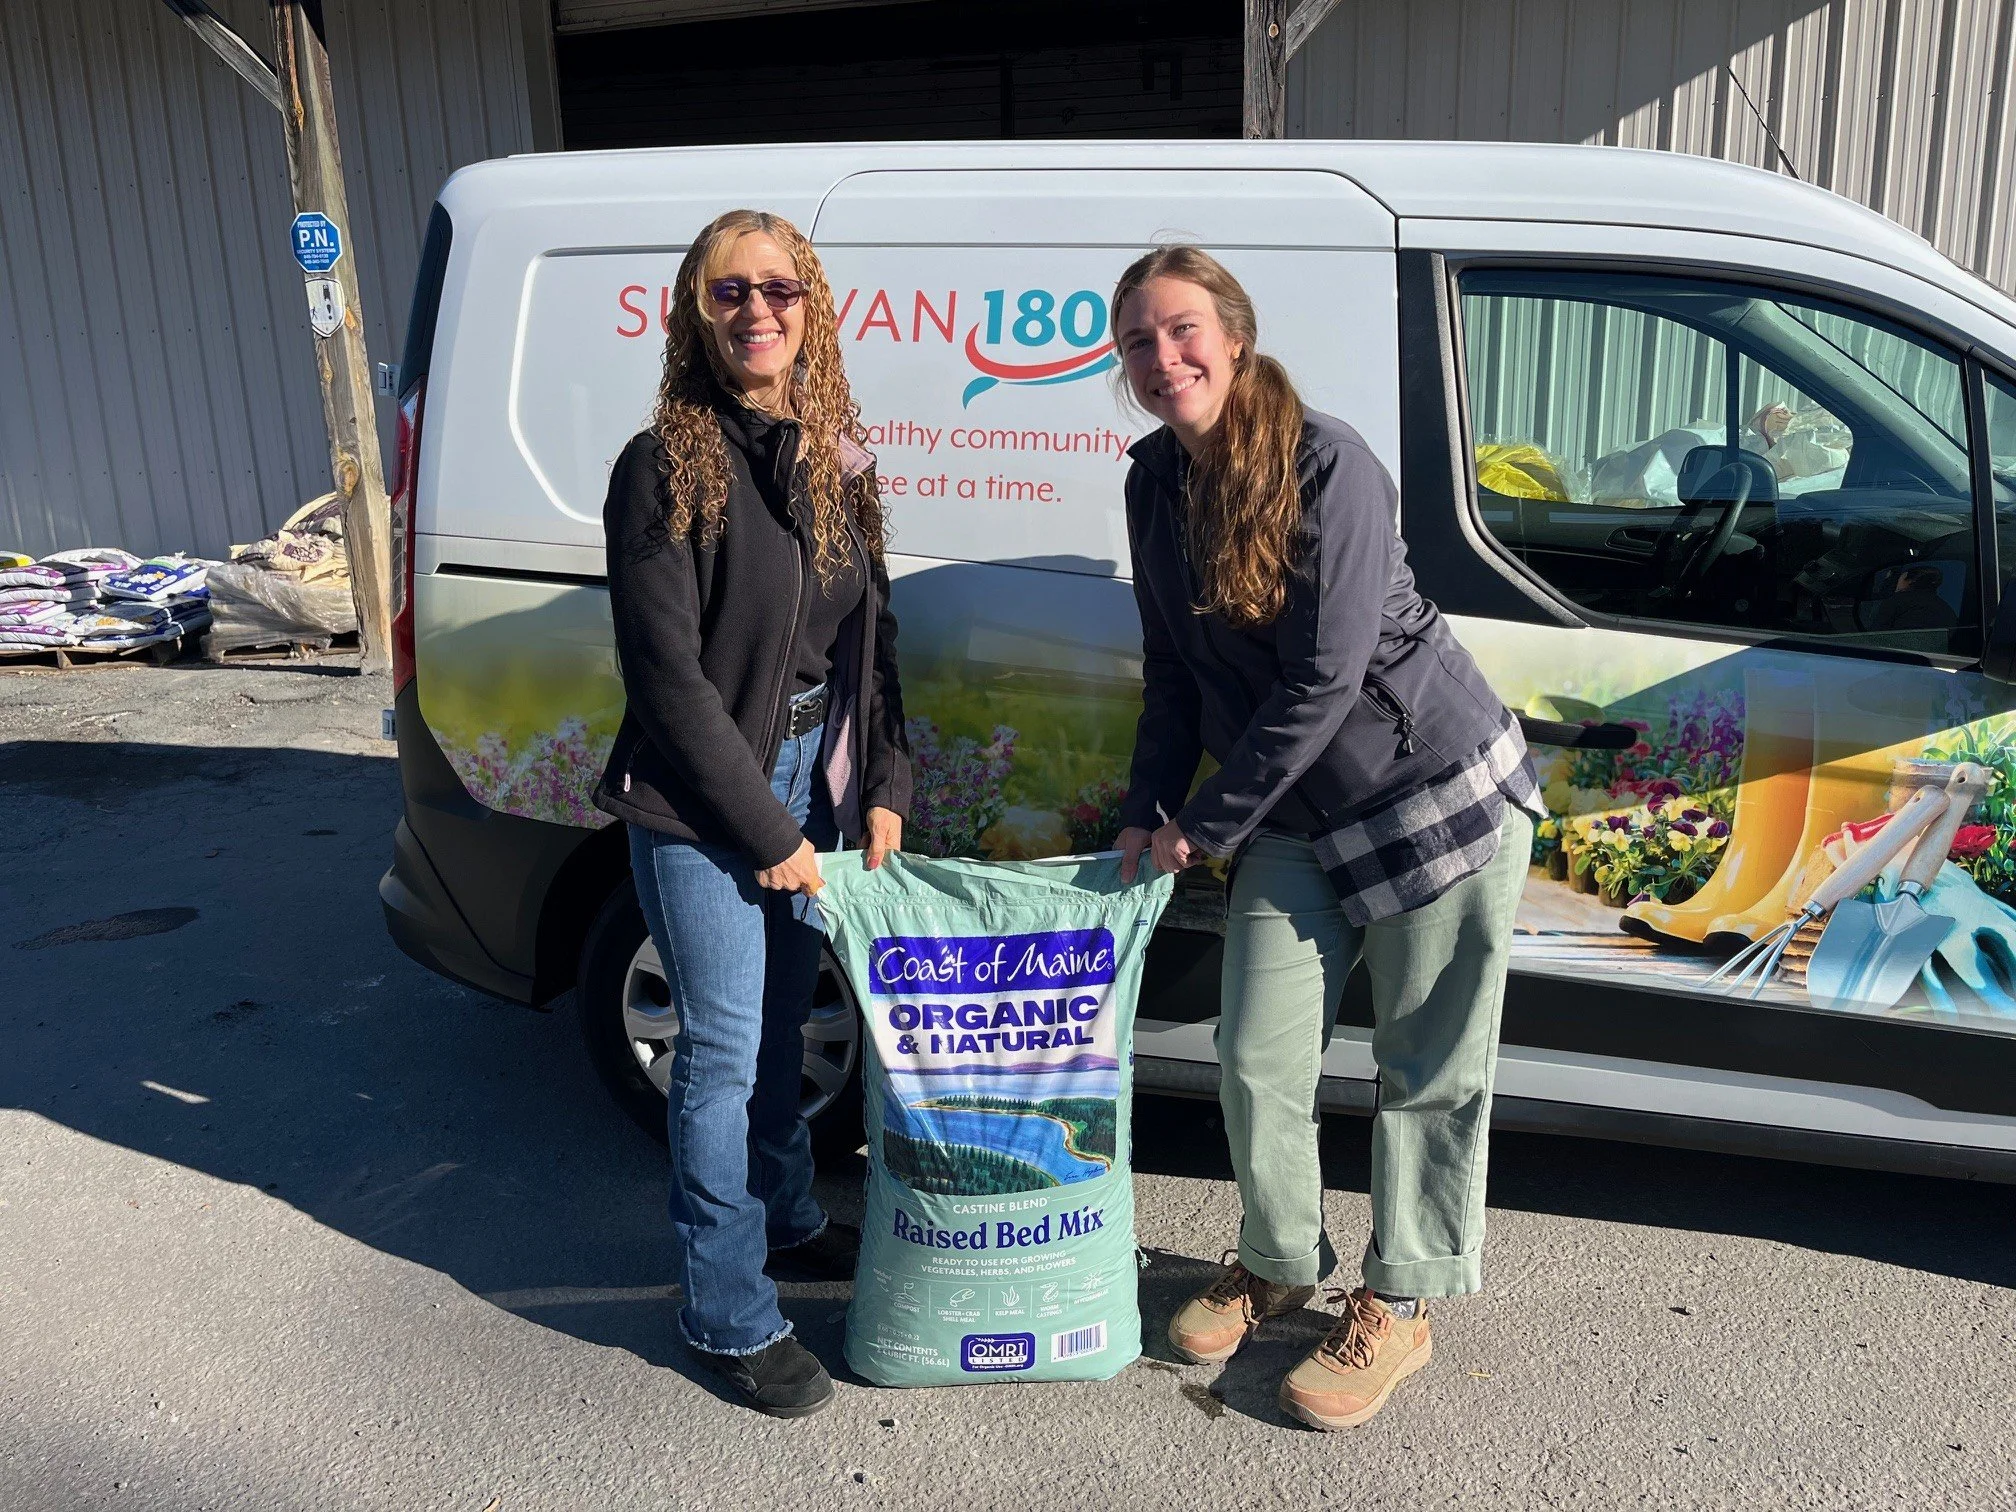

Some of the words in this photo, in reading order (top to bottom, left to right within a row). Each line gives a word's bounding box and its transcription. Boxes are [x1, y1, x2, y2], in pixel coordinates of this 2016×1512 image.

[299, 229, 334, 248] P.N.
[984, 289, 1108, 348] 180
[917, 474, 948, 497] at
[957, 479, 976, 498] a
[985, 474, 1062, 502] time.
[877, 945, 968, 985] Coast
[974, 943, 1007, 984] of
[888, 995, 1099, 1031] ORGANIC
[896, 1033, 919, 1054] &
[930, 1026, 1094, 1054] NATURAL
[953, 1203, 1005, 1214] CASTINE
[892, 1206, 988, 1250] Raised
[996, 1215, 1050, 1249] Bed
[1057, 1205, 1104, 1241] Mix
[921, 1265, 979, 1277] VEGETABLES,
[980, 1267, 1012, 1276] HERBS,
[1014, 1265, 1034, 1275] AND
[1036, 1256, 1077, 1272] FLOWERS
[932, 1257, 962, 1266] READY
[965, 1258, 978, 1266] TO
[980, 1258, 998, 1266] USE
[1000, 1258, 1018, 1266] FOR
[1020, 1250, 1066, 1265] GROWING
[893, 1301, 920, 1313] COMPOST
[1036, 1309, 1062, 1318] CASTINGS
[877, 1336, 893, 1348] NET
[893, 1342, 939, 1356] CONTENTS
[882, 1349, 907, 1360] CUBIC
[908, 1354, 920, 1363] FT.
[972, 1342, 1025, 1357] OMRI
